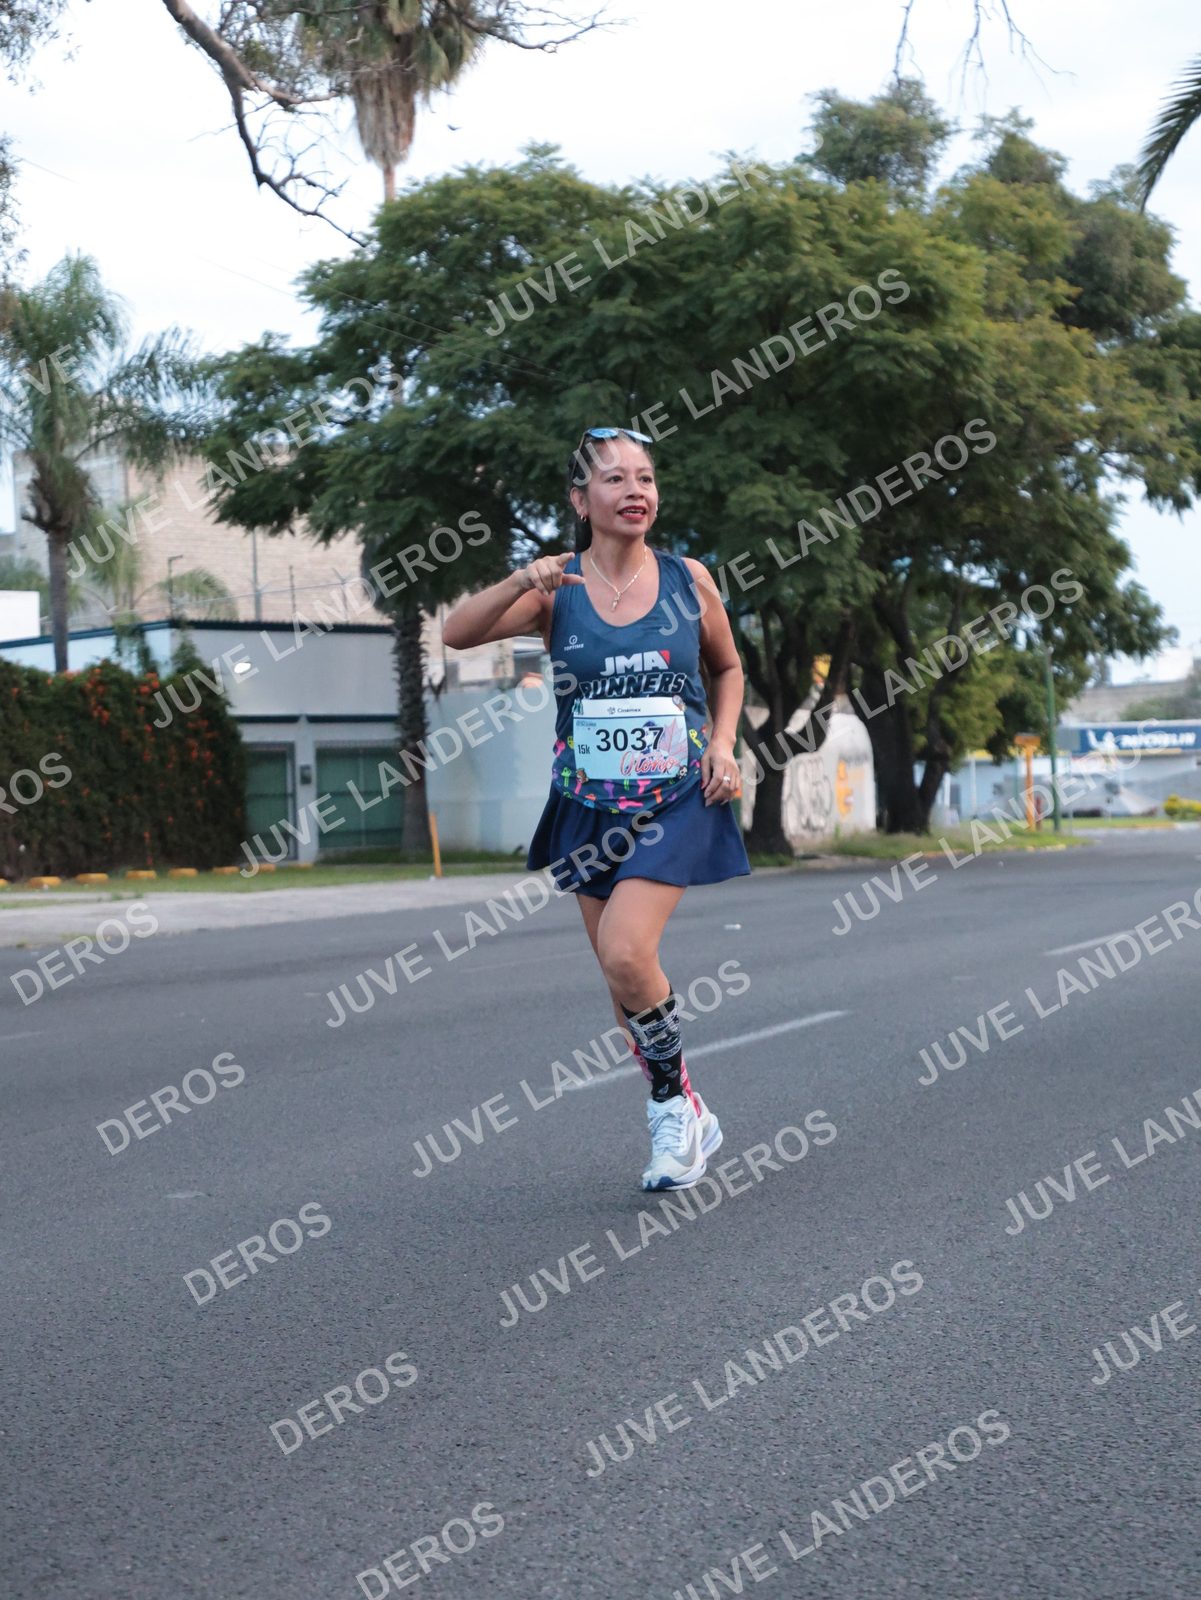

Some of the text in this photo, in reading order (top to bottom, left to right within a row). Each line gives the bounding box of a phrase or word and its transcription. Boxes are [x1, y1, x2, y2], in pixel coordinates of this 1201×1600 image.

[600, 650, 669, 677] JMA
[579, 672, 687, 698] RUNNERS
[577, 744, 591, 755] 15k
[595, 727, 664, 752] 3037
